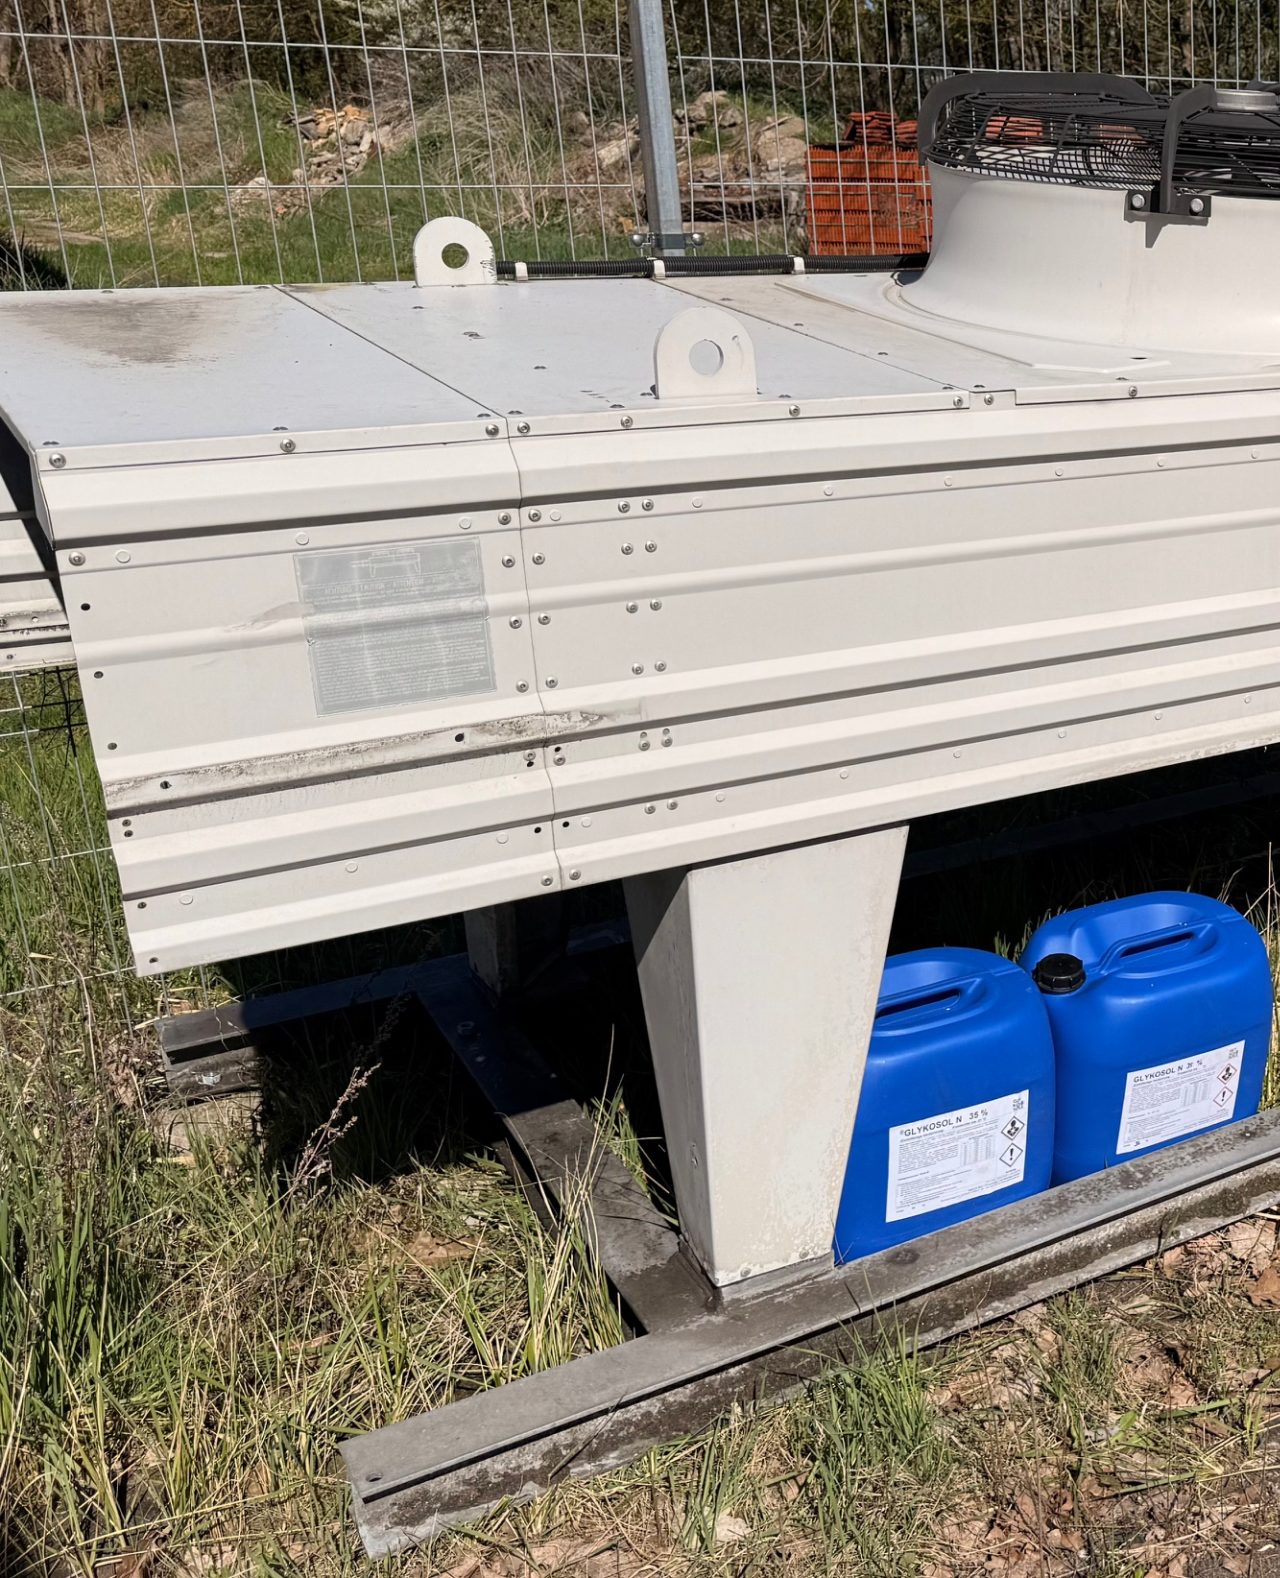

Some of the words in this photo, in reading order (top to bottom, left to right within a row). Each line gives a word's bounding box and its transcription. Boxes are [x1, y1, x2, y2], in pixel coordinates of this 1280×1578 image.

[956, 1115, 963, 1124] N
[969, 1111, 979, 1120] 35
[981, 1108, 988, 1116] %
